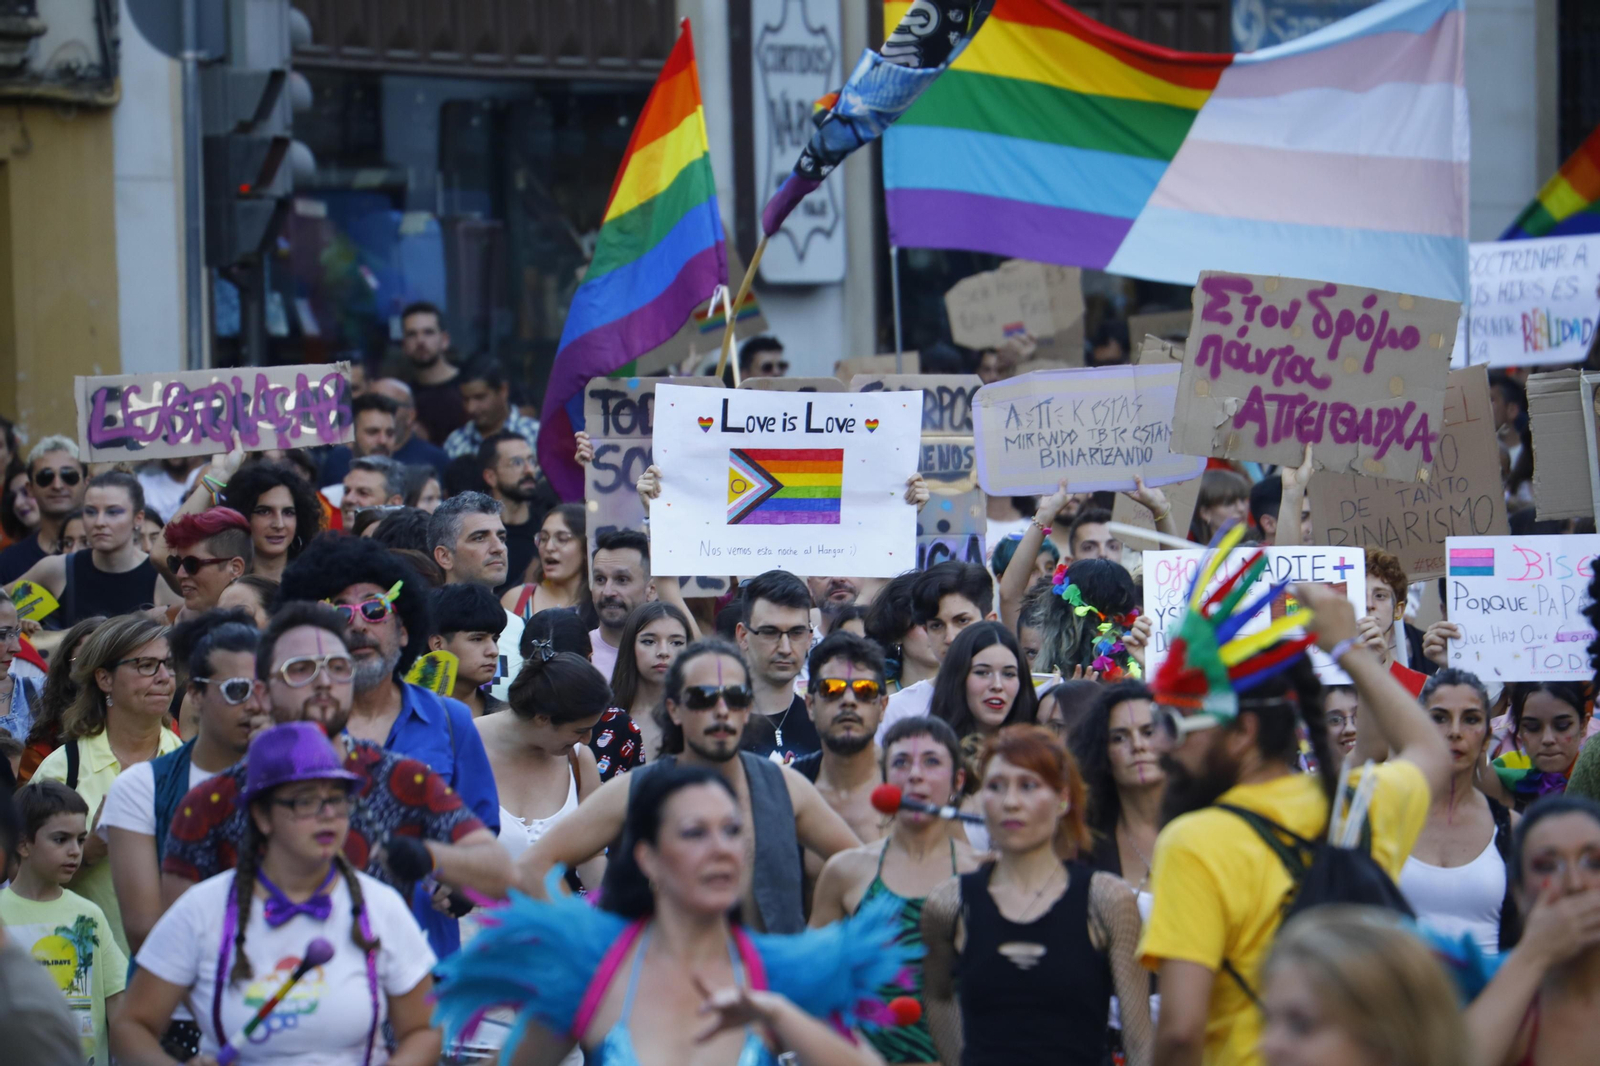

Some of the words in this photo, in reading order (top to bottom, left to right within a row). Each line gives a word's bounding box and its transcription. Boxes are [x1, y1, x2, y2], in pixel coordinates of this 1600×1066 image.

[1520, 307, 1594, 353] REALIDAD
[782, 412, 798, 432] is
[1073, 400, 1085, 427] K
[1005, 428, 1078, 452] MIRANDO
[1040, 443, 1153, 468] BINARIZANDO
[1340, 496, 1371, 523] DE
[1395, 476, 1469, 508] TANTO
[1327, 494, 1494, 549] BINARISMO
[699, 540, 721, 557] Nos
[727, 546, 751, 556] vemos
[757, 545, 773, 556] esta
[777, 546, 799, 556] noche
[803, 545, 812, 554] al
[817, 544, 845, 558] Hangar
[38, 958, 71, 966] OLIDAYS
